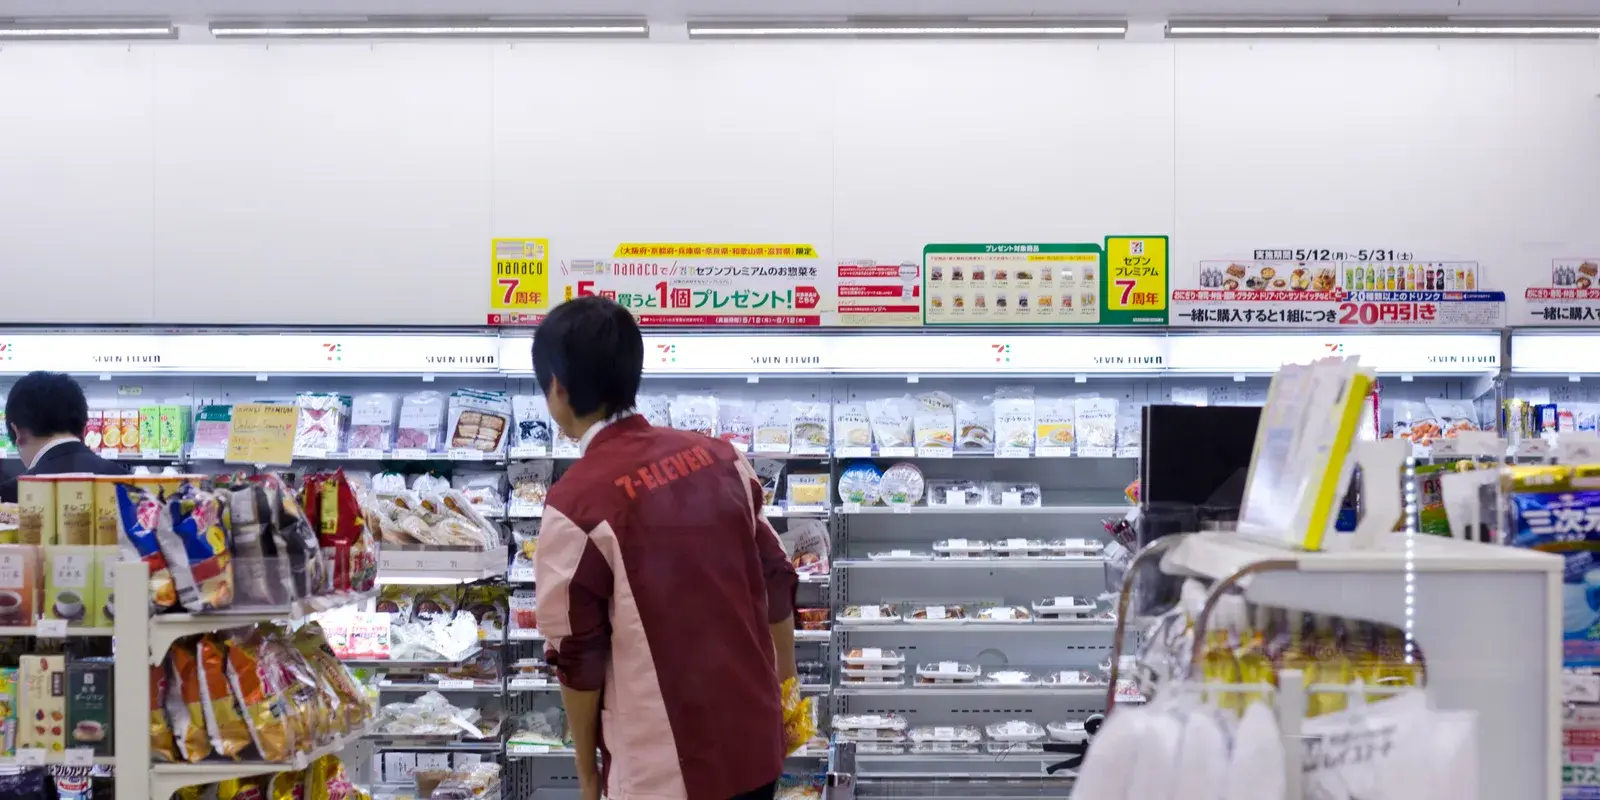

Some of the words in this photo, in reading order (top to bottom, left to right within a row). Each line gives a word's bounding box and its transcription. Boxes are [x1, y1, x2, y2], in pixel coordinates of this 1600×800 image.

[1124, 257, 1151, 266] セブン
[497, 262, 543, 275] nanaco
[1115, 267, 1159, 276] プレミアム
[498, 279, 542, 304] 7周年
[1115, 280, 1159, 305] 7周年
[1351, 292, 1441, 302] 20種類以上のドリンク
[1530, 307, 1600, 320] 一緒に購入
